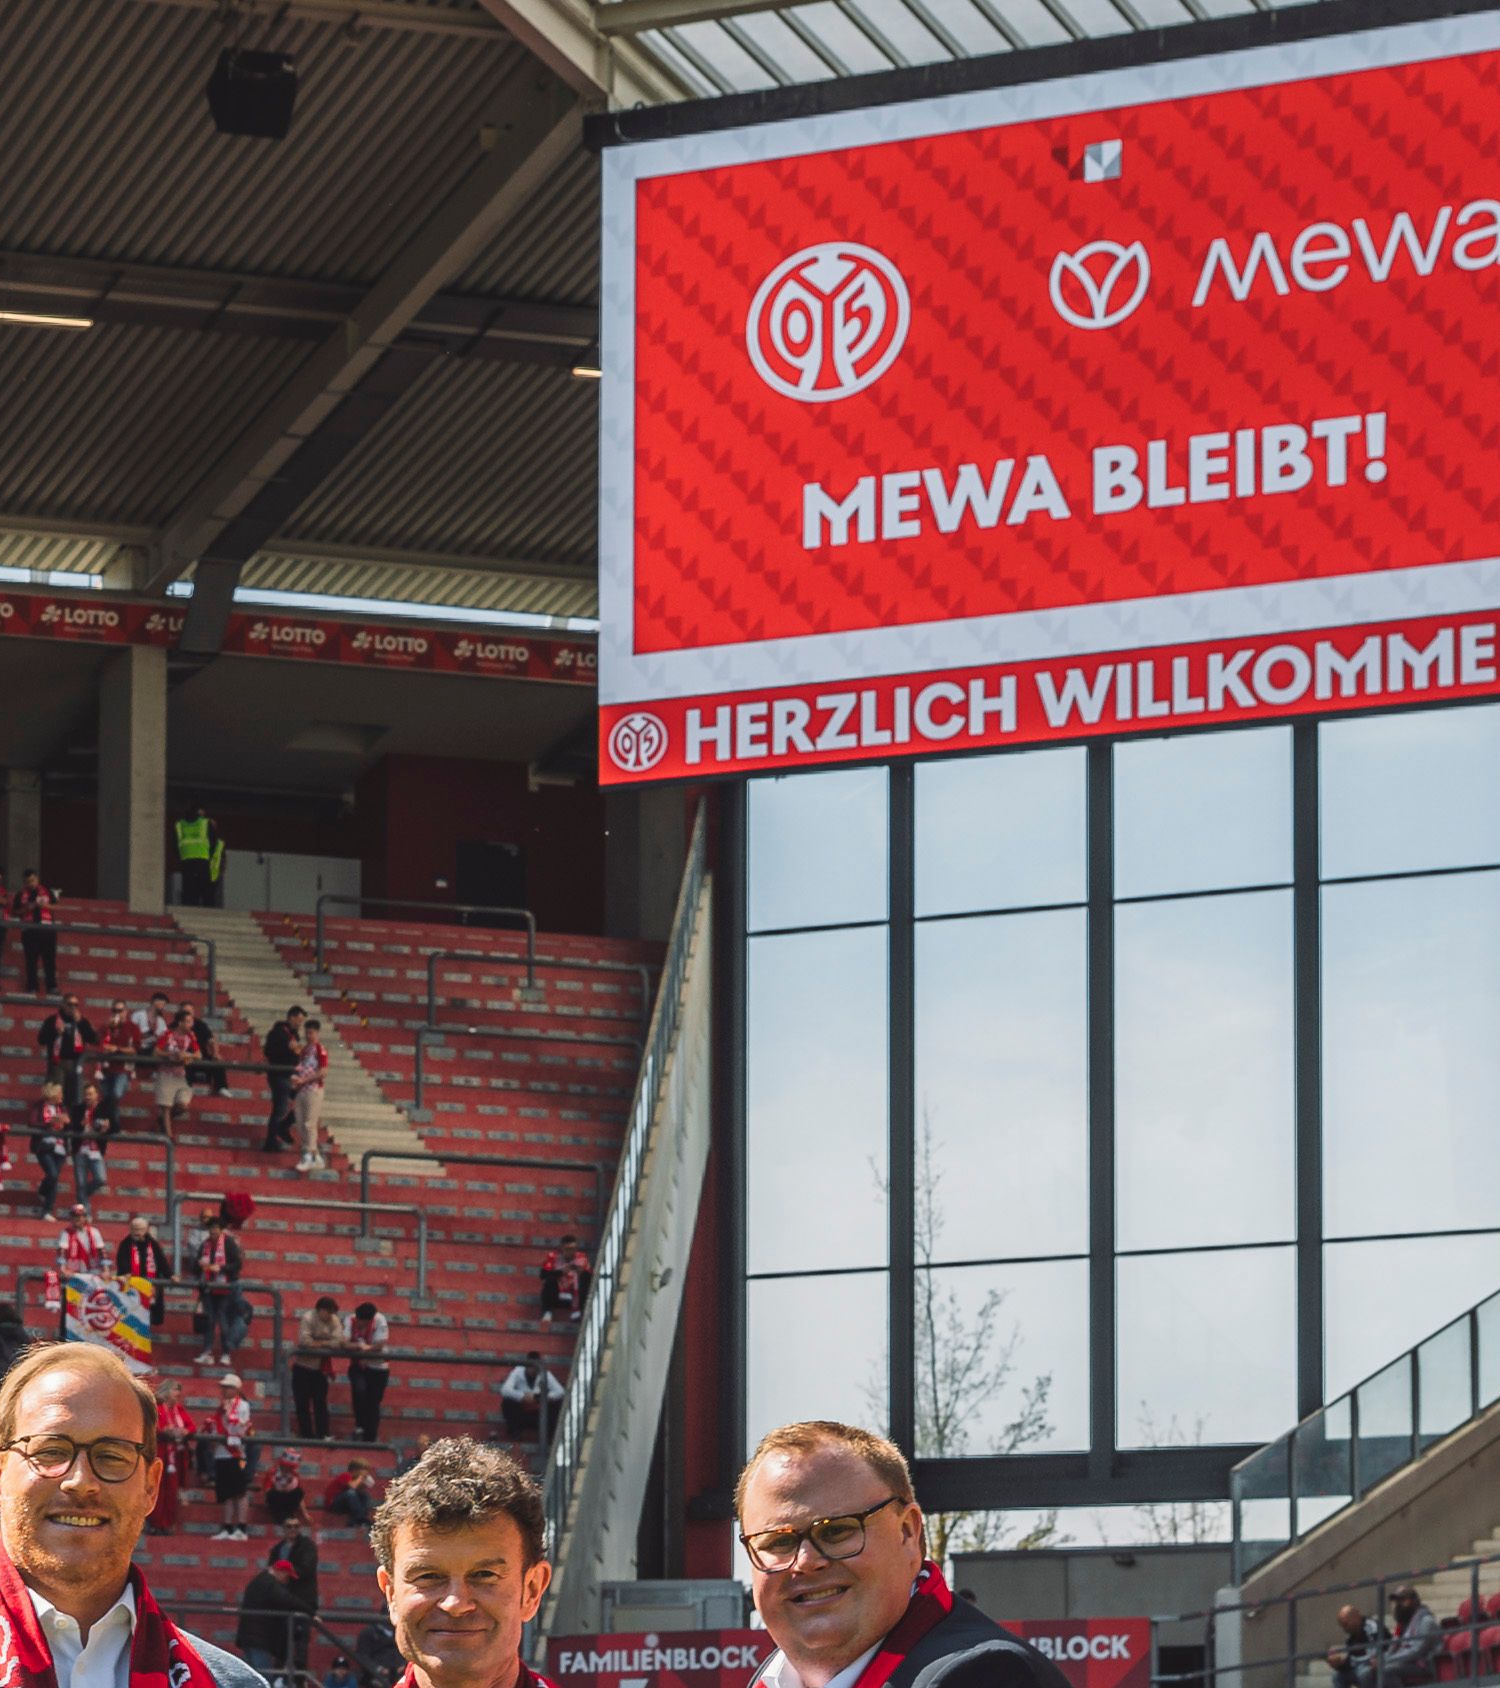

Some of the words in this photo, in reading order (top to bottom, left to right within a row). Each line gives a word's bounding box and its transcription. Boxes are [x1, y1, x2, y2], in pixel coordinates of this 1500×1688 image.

[803, 454, 1071, 550] MEWA
[1093, 412, 1388, 514] BLEIBT!
[64, 607, 120, 628] LOTTO
[271, 624, 326, 644] LOTTO
[374, 634, 428, 654] LOTTO
[476, 643, 529, 662] LOTTO
[685, 667, 1016, 765] HERZLICH
[559, 1643, 759, 1674] FAMILIENBLOCK
